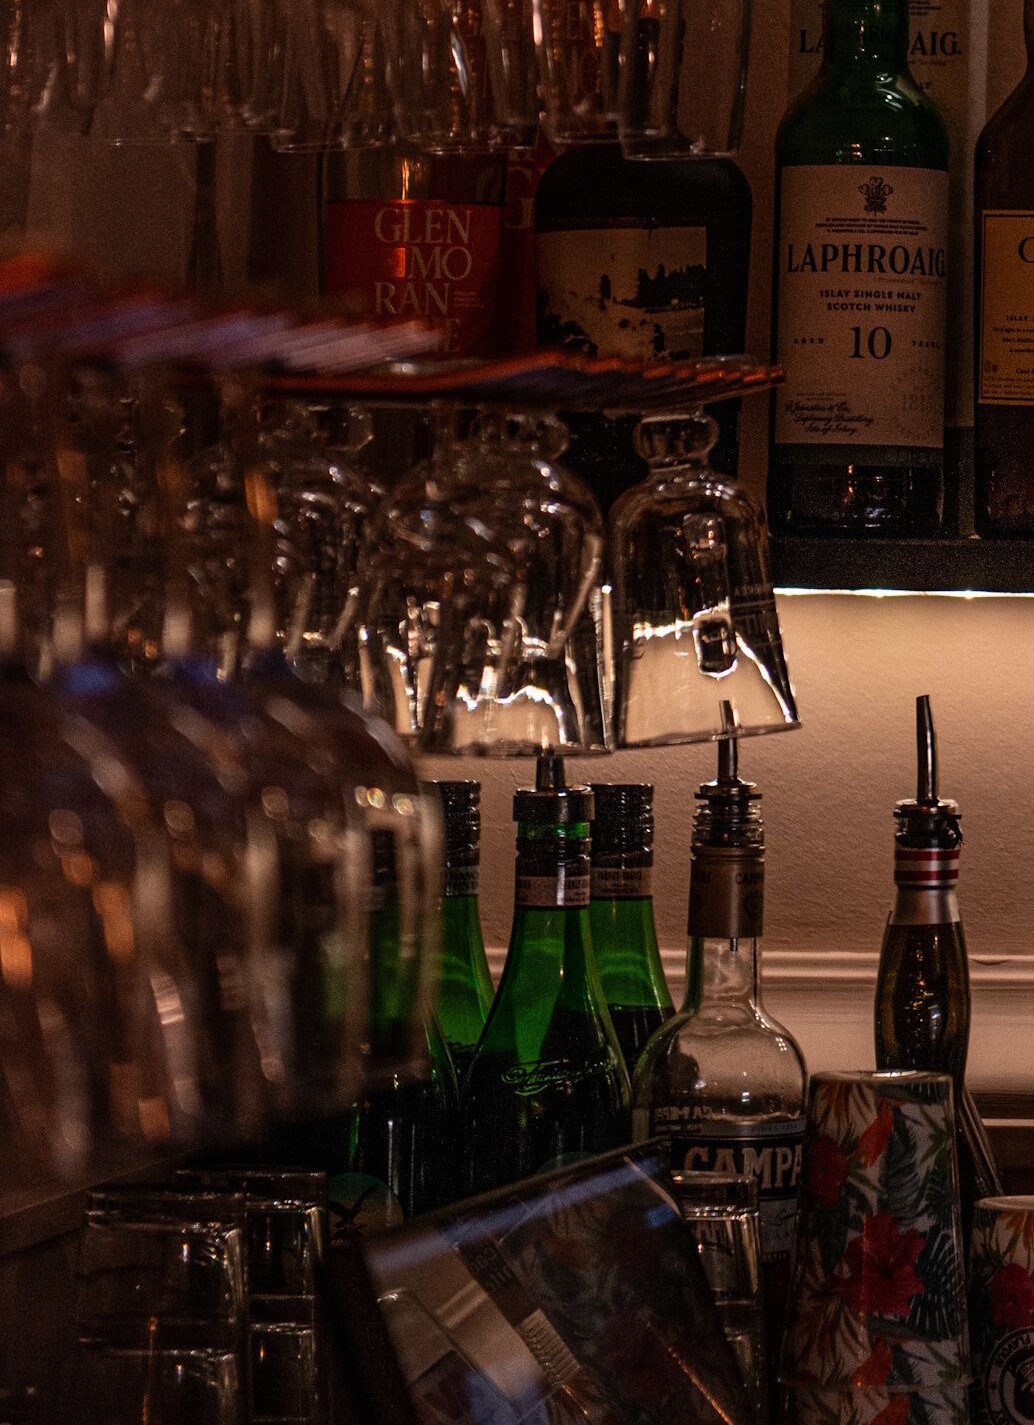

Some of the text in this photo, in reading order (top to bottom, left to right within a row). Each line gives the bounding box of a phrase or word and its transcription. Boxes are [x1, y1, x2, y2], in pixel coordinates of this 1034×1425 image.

[374, 208, 472, 245] GLEN
[408, 246, 472, 281] MO
[787, 243, 945, 278] LAPHROAIG
[374, 281, 450, 315] RAN
[820, 289, 922, 301] ISLAY SINGLE MALT
[827, 302, 916, 313] SCOTCH WHISKY
[849, 326, 892, 360] 10
